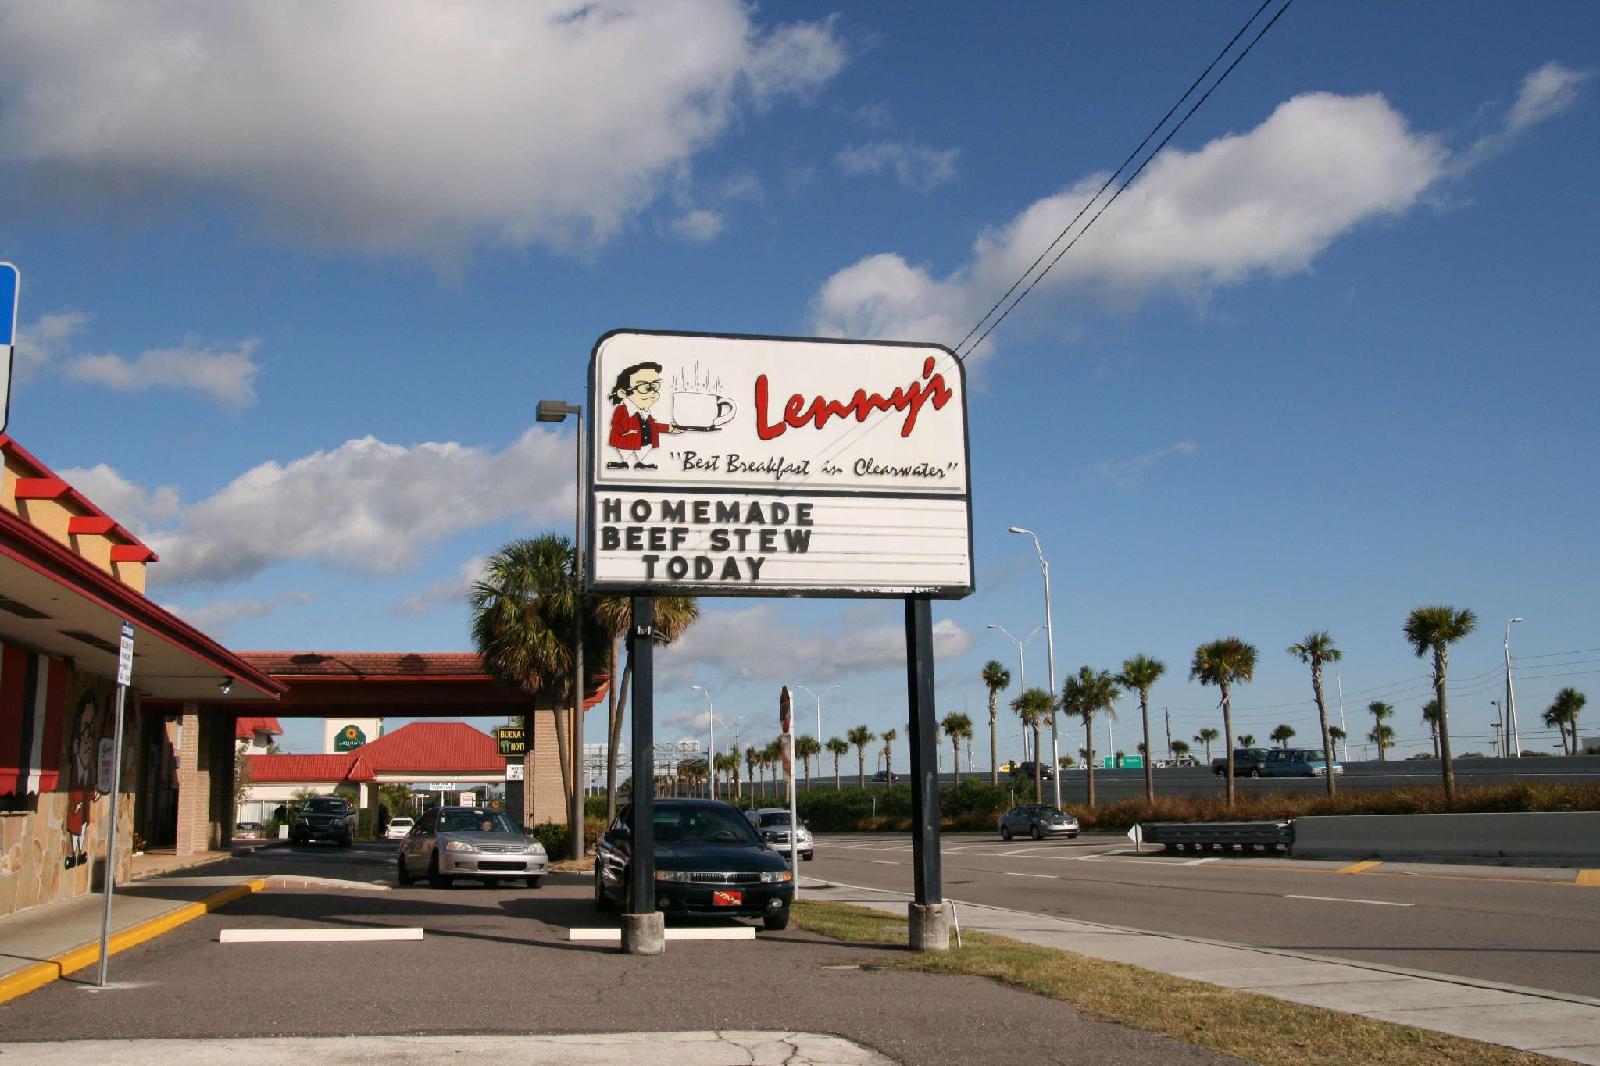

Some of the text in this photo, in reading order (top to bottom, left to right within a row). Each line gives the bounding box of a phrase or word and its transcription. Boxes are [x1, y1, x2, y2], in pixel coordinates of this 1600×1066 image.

[755, 356, 953, 441] Lenny's
[726, 453, 811, 481] Breakfast
[821, 460, 843, 476] in
[602, 498, 814, 526] HOMEMADE
[601, 526, 812, 554] BEEF STEW
[642, 554, 766, 580] TODAY
